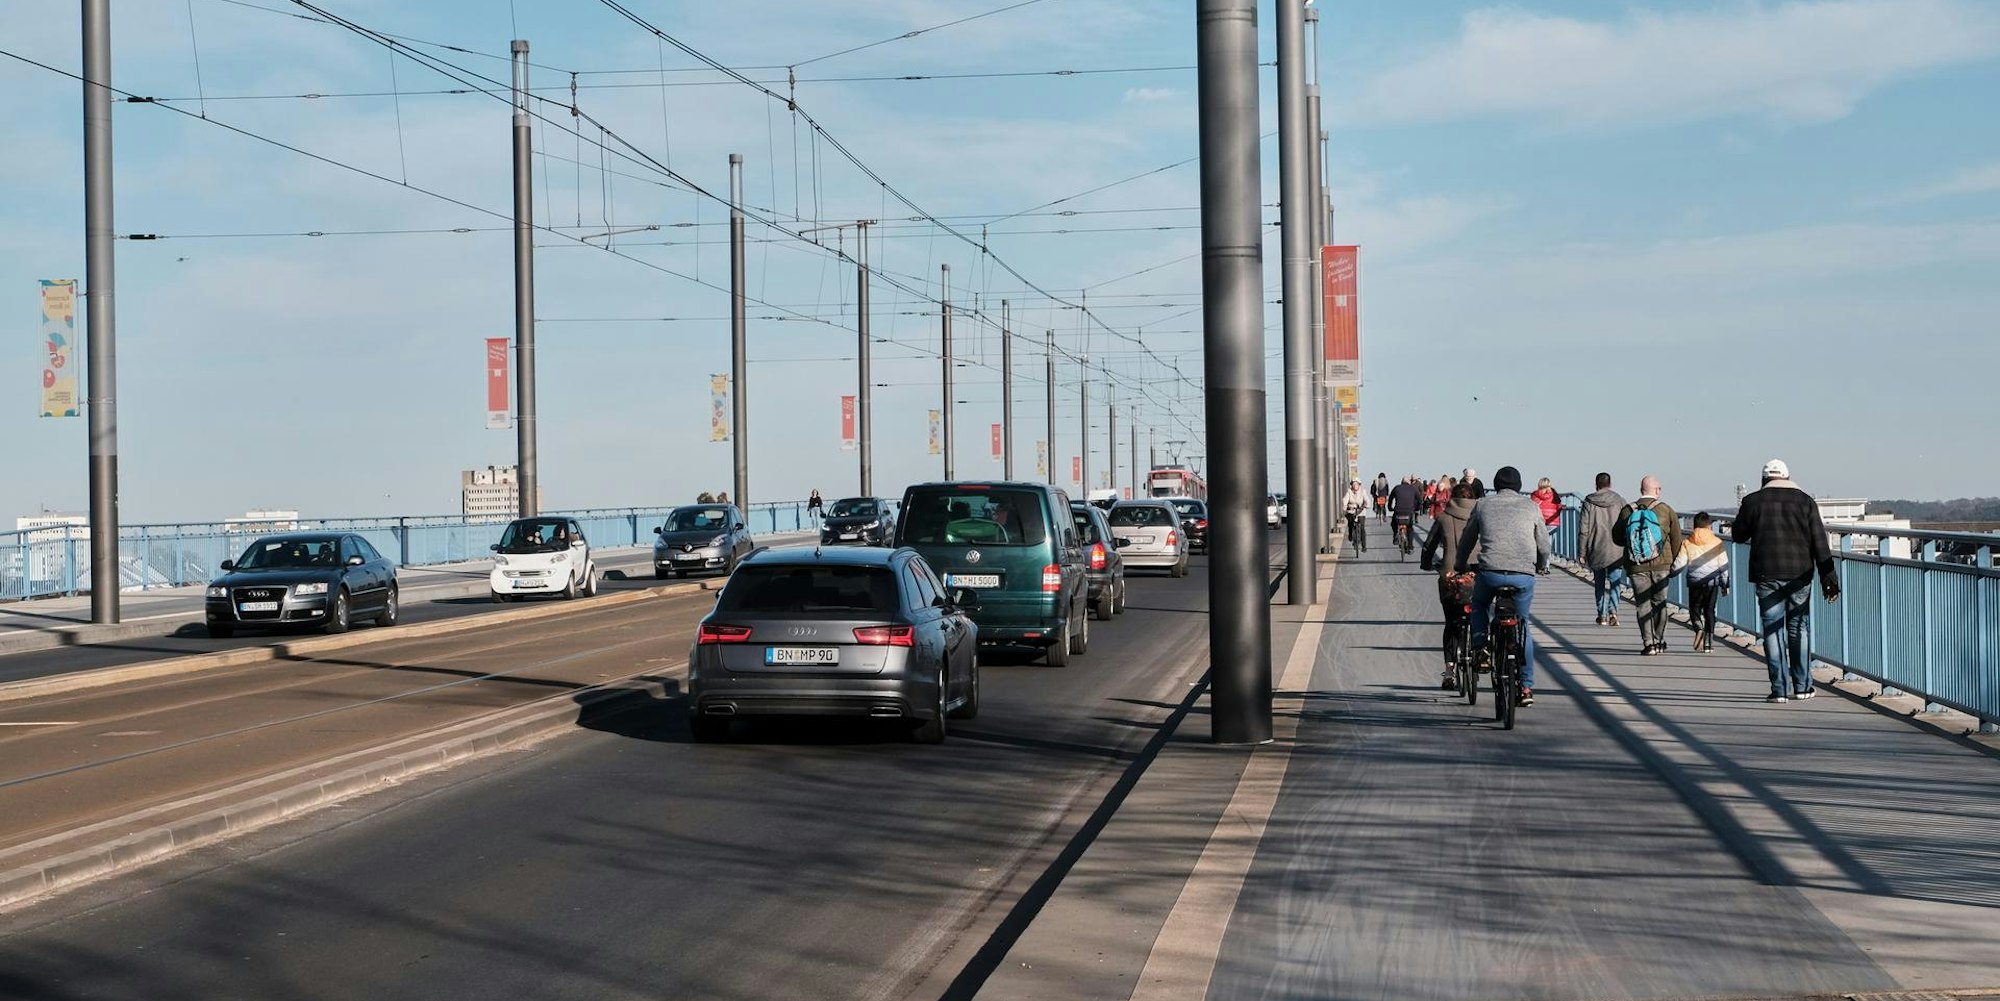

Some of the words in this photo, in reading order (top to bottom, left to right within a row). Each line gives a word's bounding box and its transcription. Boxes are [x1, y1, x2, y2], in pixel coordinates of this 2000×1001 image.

[953, 576, 964, 585] BN
[978, 576, 997, 585] 5000
[777, 650, 793, 660] BN
[800, 650, 815, 660] MP
[818, 650, 833, 660] 90
